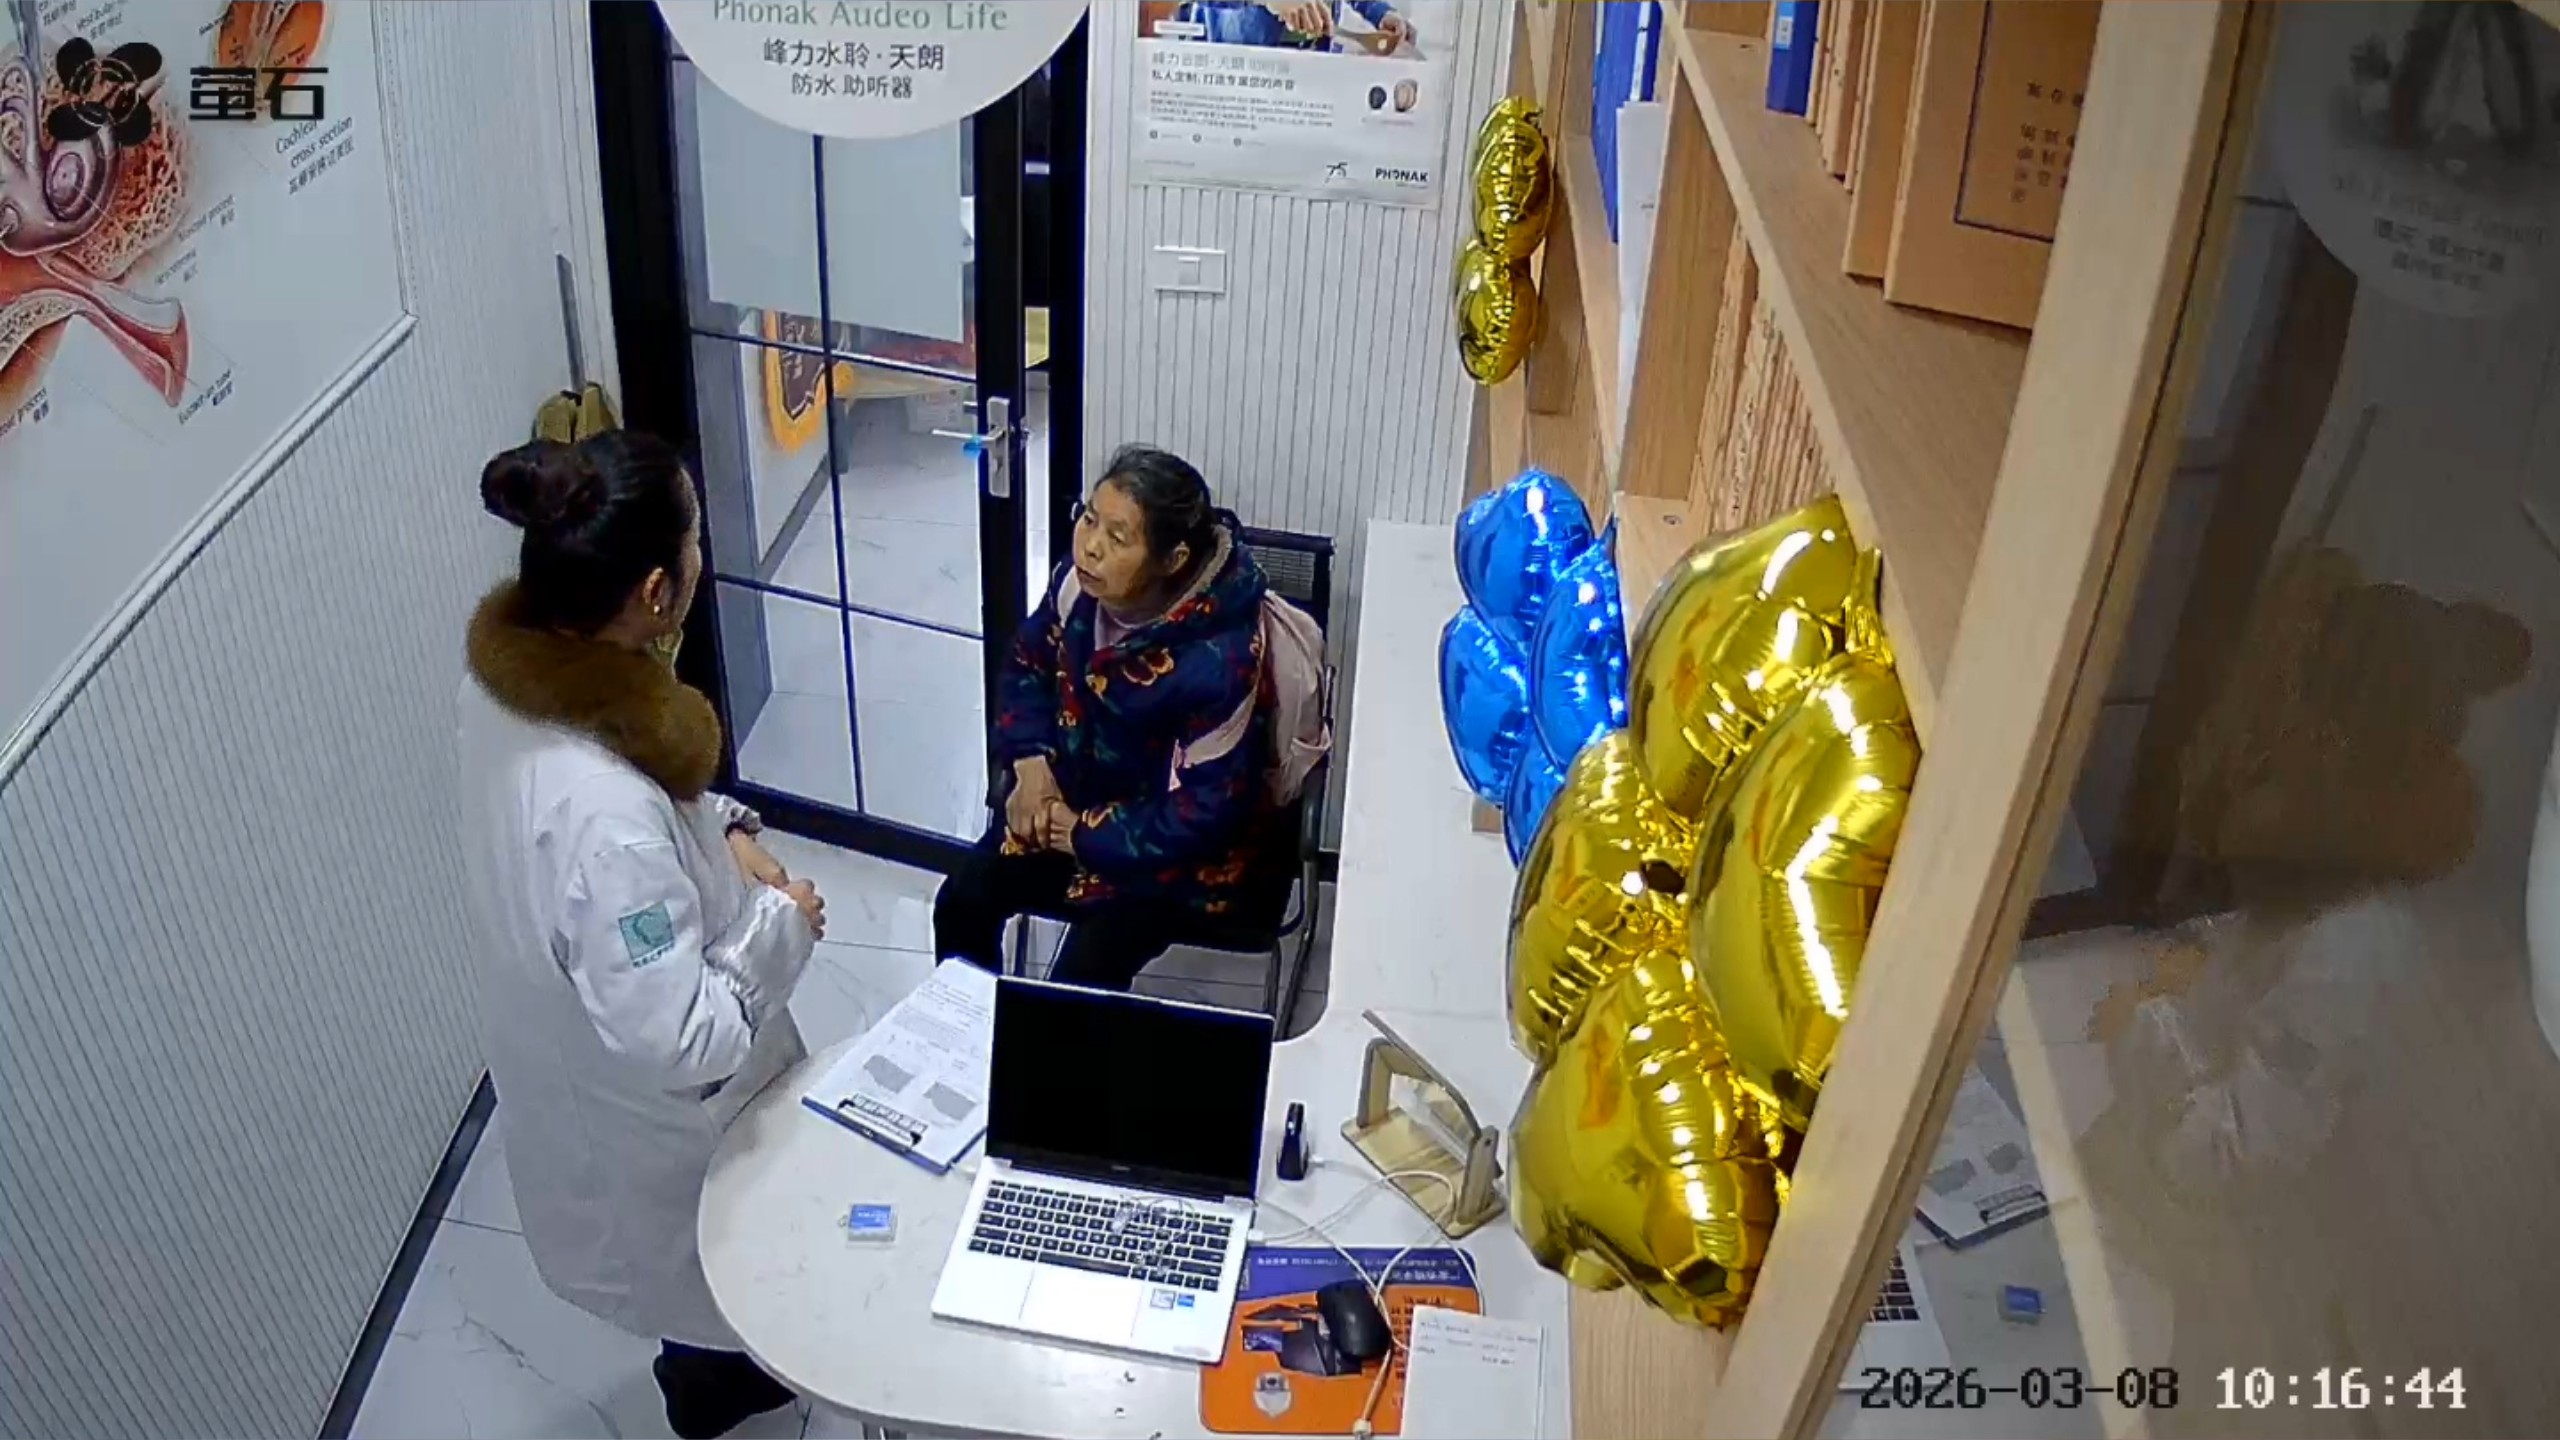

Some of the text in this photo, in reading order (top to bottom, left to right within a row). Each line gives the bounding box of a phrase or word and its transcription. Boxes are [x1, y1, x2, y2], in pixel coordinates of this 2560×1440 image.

[714, 0, 1007, 31] Phonak Audeo Life
[791, 72, 913, 98] 防水 助听器
[1375, 167, 1428, 182] PHONAK
